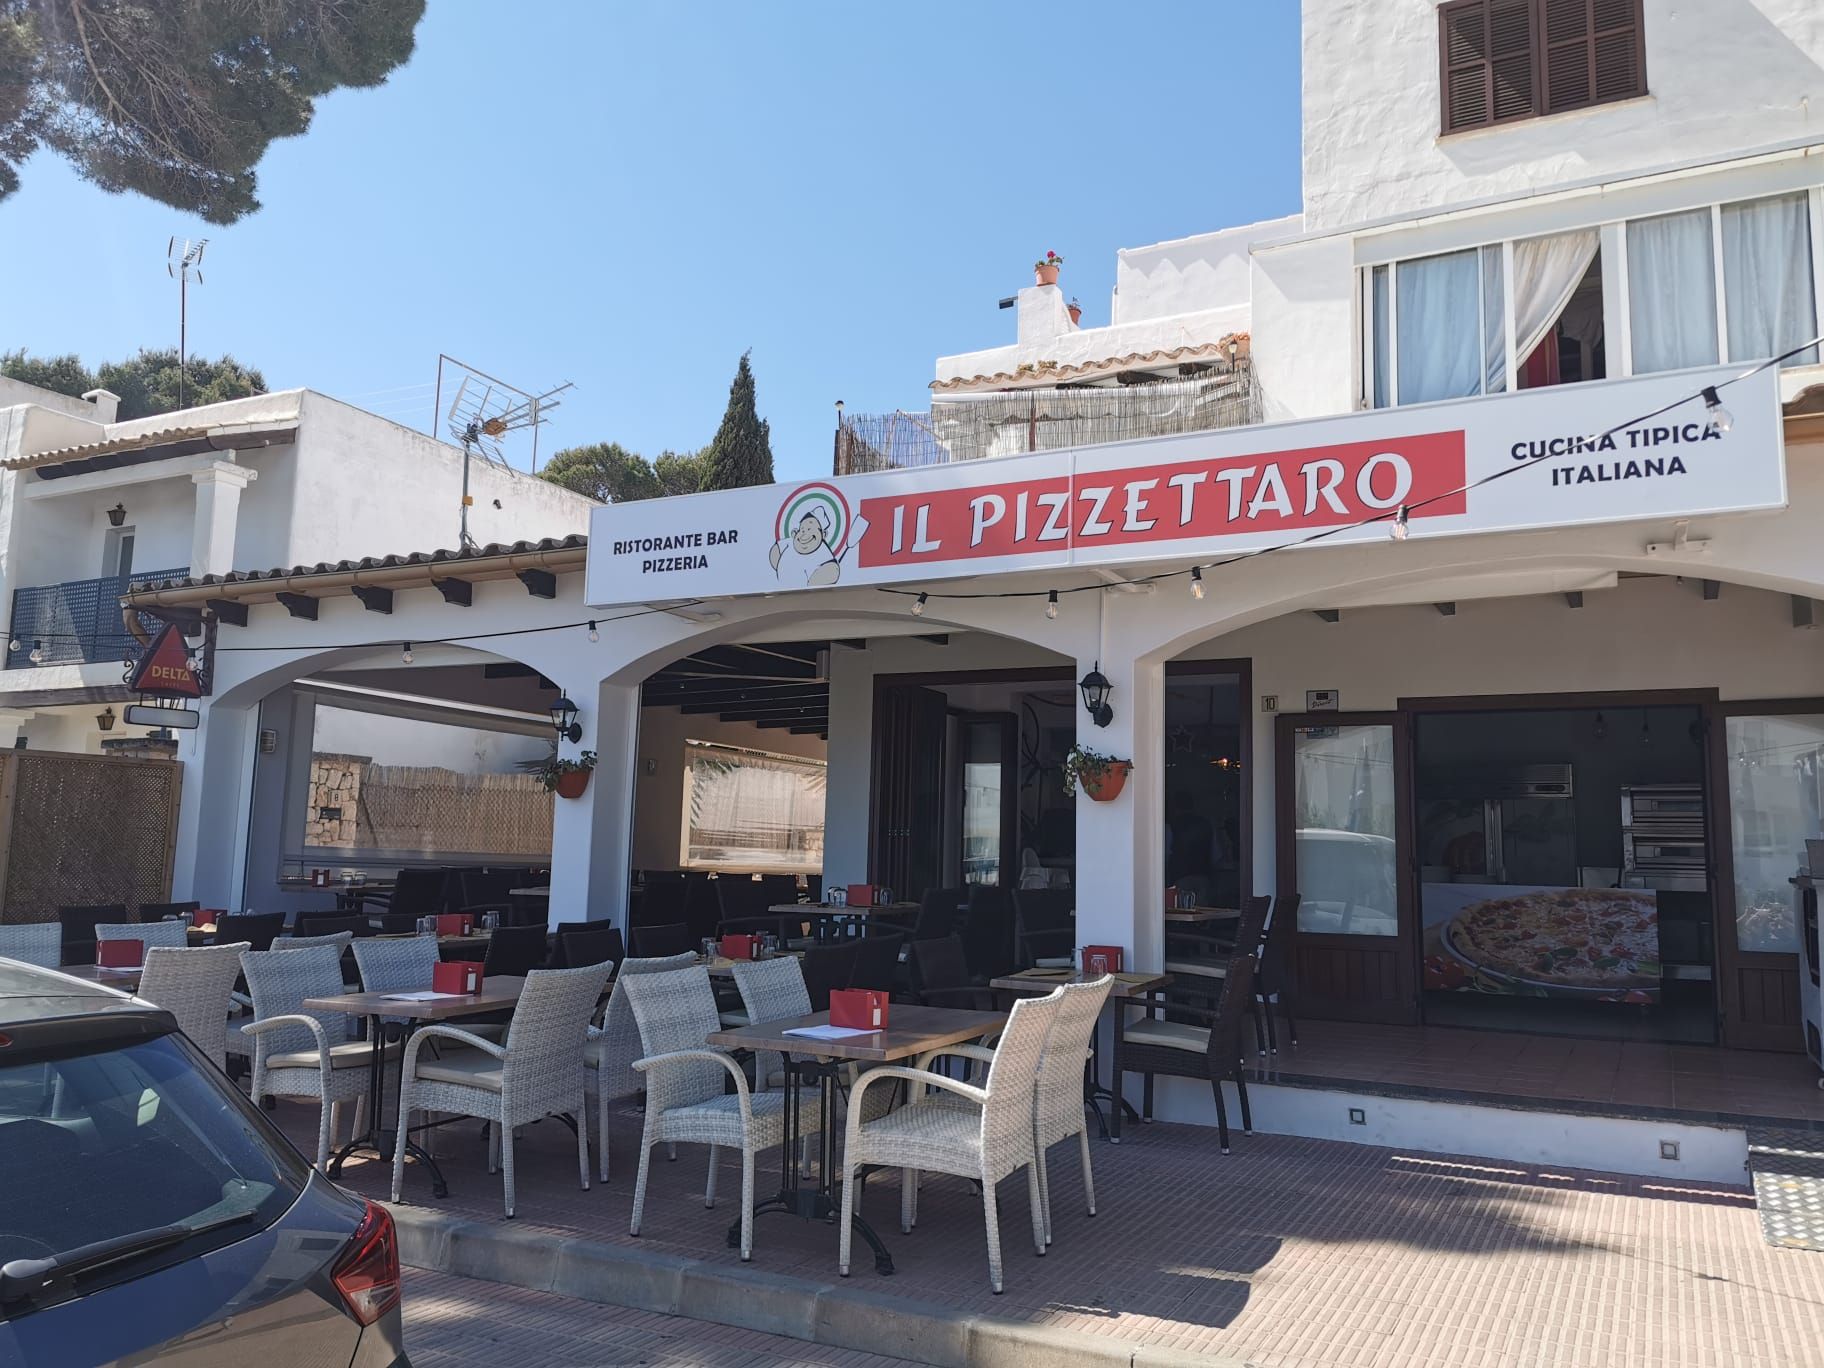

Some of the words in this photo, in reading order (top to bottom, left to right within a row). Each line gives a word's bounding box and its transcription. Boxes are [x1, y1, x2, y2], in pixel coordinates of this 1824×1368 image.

[1511, 433, 1616, 460] CUCINA
[1626, 422, 1721, 448] TIPICA
[1552, 456, 1687, 486] ITALIANA
[890, 504, 941, 555] IL
[968, 452, 1413, 550] PIZZETTARO
[613, 533, 703, 555] RISTORANTE
[707, 530, 738, 546] BAR
[642, 555, 708, 573] PIZZERIA
[151, 665, 190, 681] DELTA
[1265, 697, 1275, 710] 10
